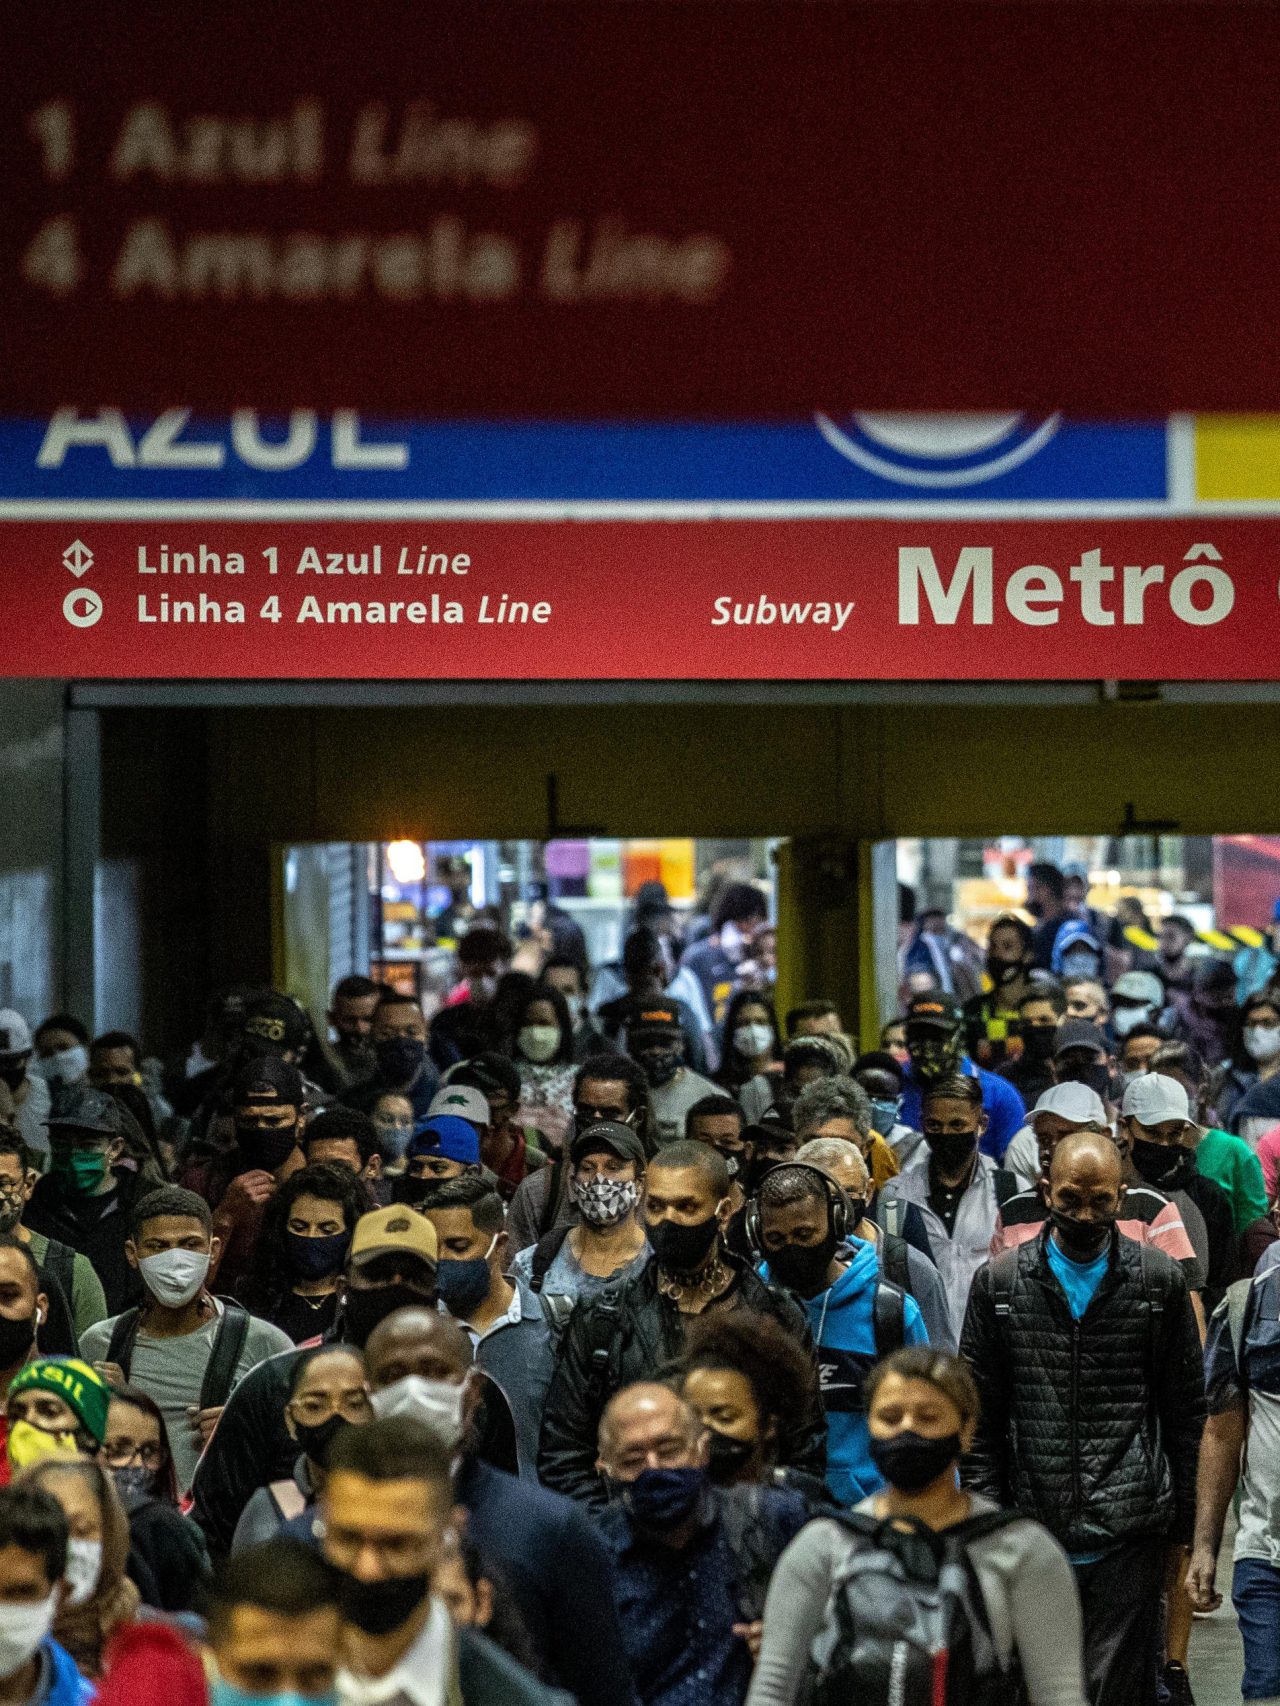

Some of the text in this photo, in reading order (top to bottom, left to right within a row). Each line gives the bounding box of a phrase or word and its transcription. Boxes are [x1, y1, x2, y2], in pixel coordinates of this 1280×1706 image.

[33, 103, 535, 183] 1 Azul Line
[24, 218, 728, 301] 4 Amarela Line
[137, 545, 472, 576] Linha 1 Azul Line
[897, 542, 1235, 627] Metrô
[137, 593, 552, 624] Linha 4 Amarela Line
[711, 595, 855, 632] Subway
